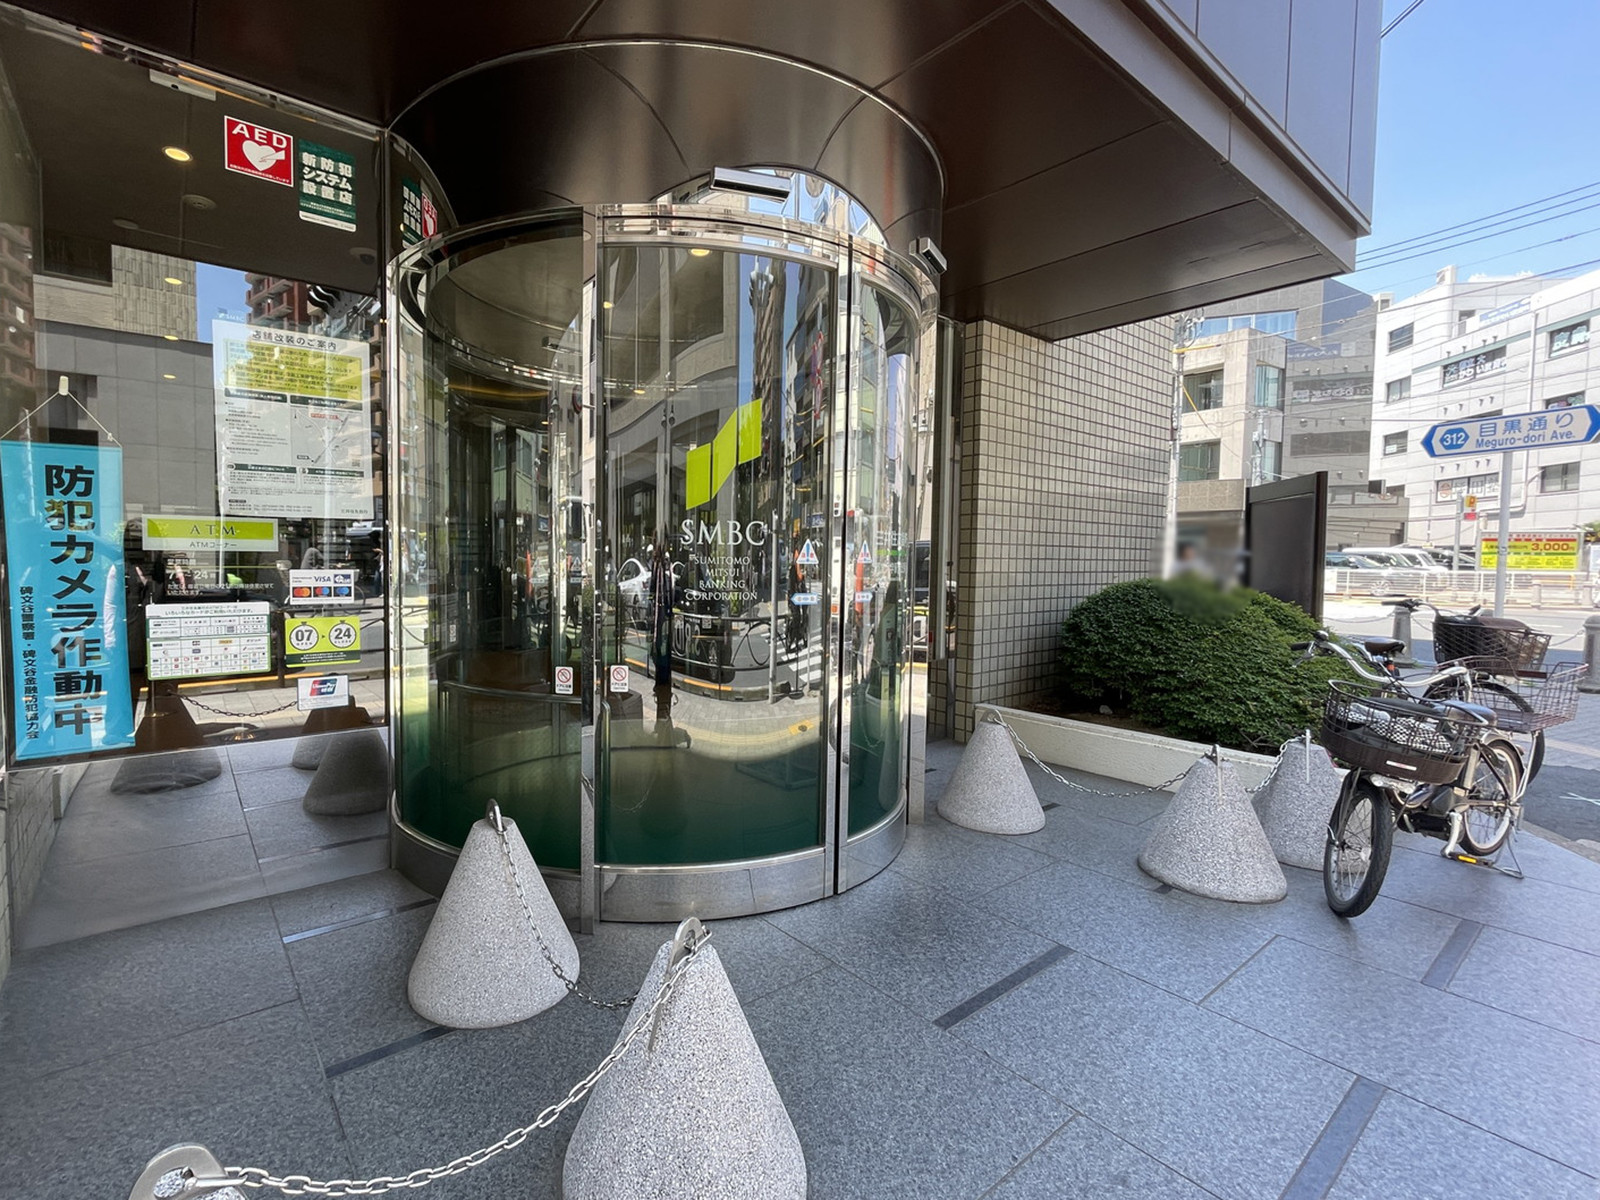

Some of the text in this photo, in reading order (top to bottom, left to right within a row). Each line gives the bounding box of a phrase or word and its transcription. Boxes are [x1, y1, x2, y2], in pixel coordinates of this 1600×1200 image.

[232, 123, 287, 148] AED
[302, 152, 352, 178] 新防犯
[302, 166, 353, 191] システム
[302, 180, 353, 205] 設置店
[253, 330, 337, 350] 店舗改装のご案内
[1479, 412, 1574, 437] 目黒通り
[1443, 432, 1466, 446] 312
[1475, 429, 1575, 448] Meguro-dori Ave.
[189, 524, 236, 536] ATM
[680, 518, 766, 546] SMBC
[189, 541, 237, 549] ATMコーナー
[694, 556, 751, 565] SUMITOMO
[705, 568, 740, 577] MITSUI
[699, 580, 745, 589] BANKING
[44, 464, 102, 736] 防犯カメラ作動中
[685, 591, 758, 601] CORPORATION
[295, 629, 314, 642] 07
[334, 627, 352, 640] 24
